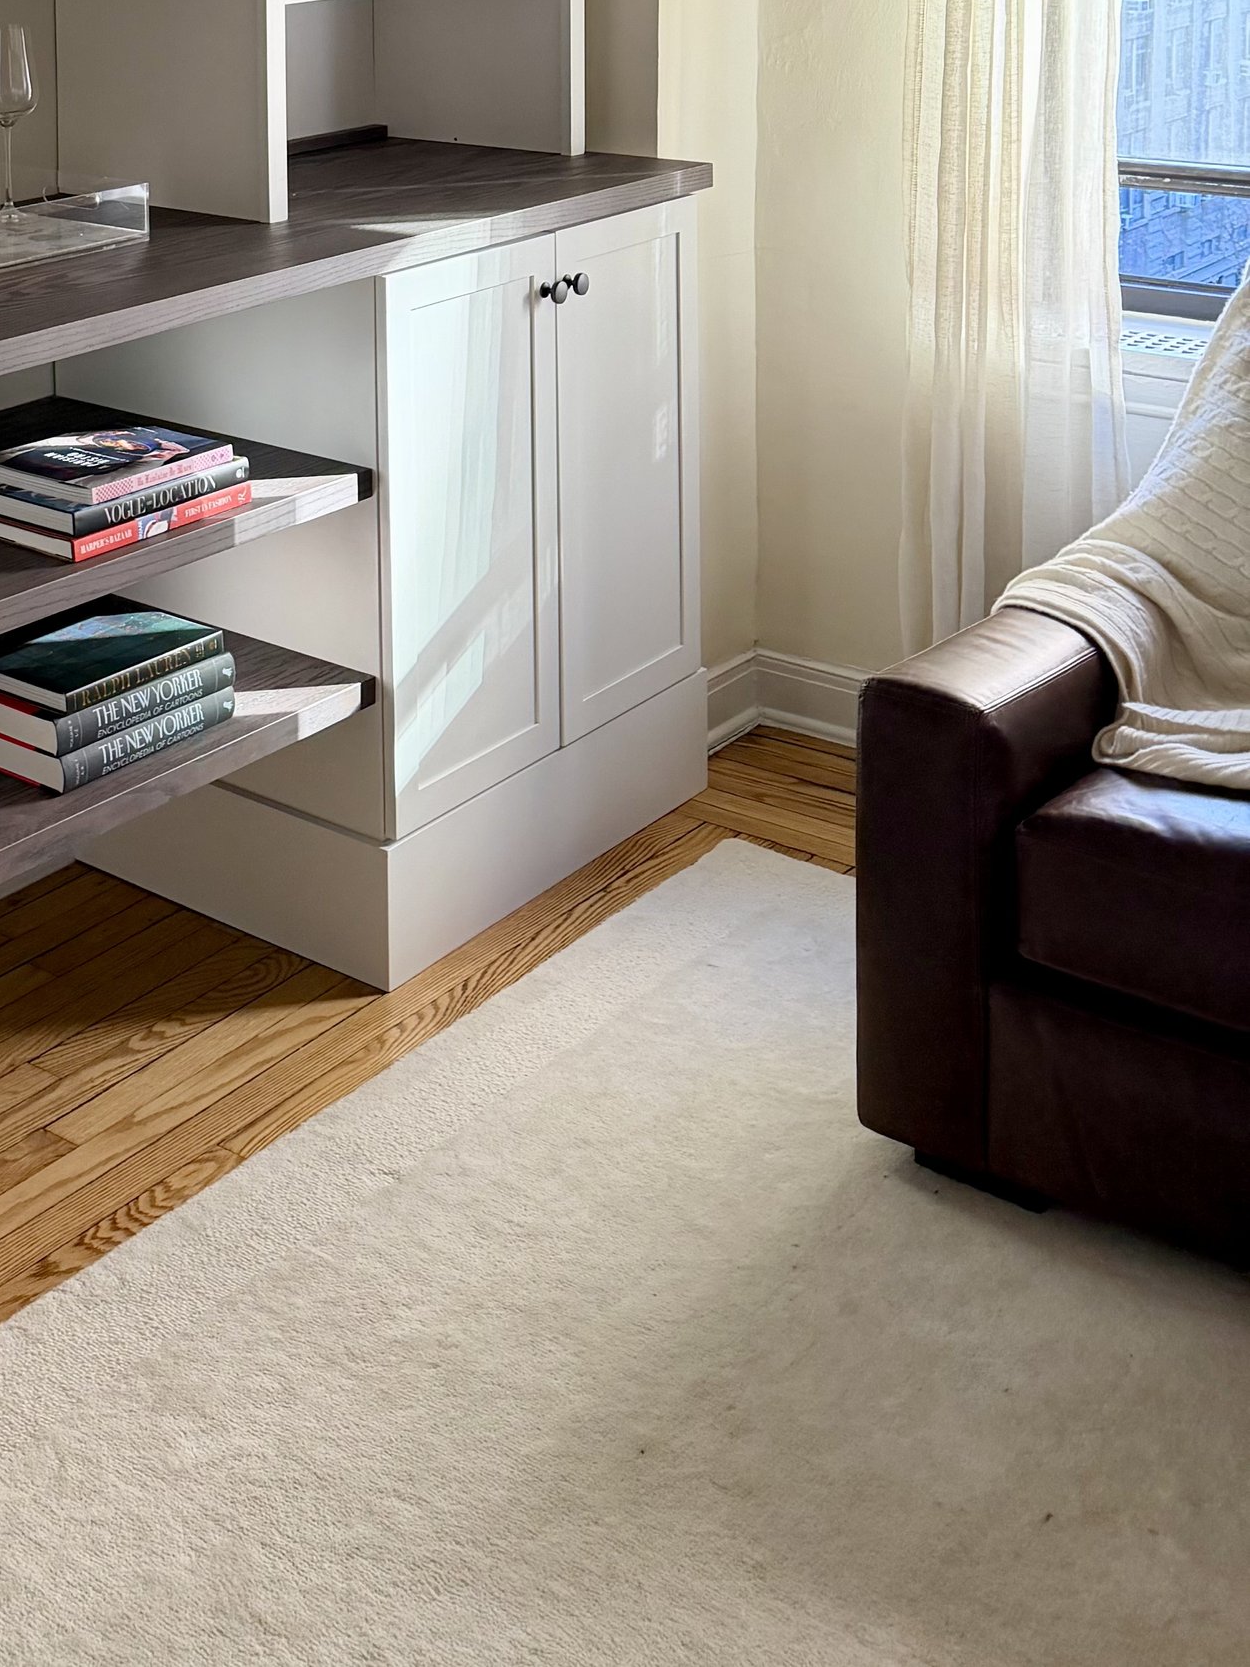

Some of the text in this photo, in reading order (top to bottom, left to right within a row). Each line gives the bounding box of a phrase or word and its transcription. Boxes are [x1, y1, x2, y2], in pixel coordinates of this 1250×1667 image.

[105, 475, 217, 525] VOGUE LOCATION
[184, 495, 233, 517] FIRST IN FASHION
[80, 528, 133, 555] HARPER'S BAZAAR
[81, 672, 131, 707] RALPH
[135, 648, 192, 684] LAUREN
[93, 669, 203, 727] THE NEW YORKER
[97, 710, 151, 738] ENCYCLOPEDIA
[151, 705, 164, 717] OF
[164, 689, 204, 714] CARTOONS
[98, 703, 204, 764] THE NEW YORKER
[101, 746, 155, 775] ENCYCLOPEDIA
[155, 740, 166, 752] OF
[166, 723, 204, 748] CARTOONS
